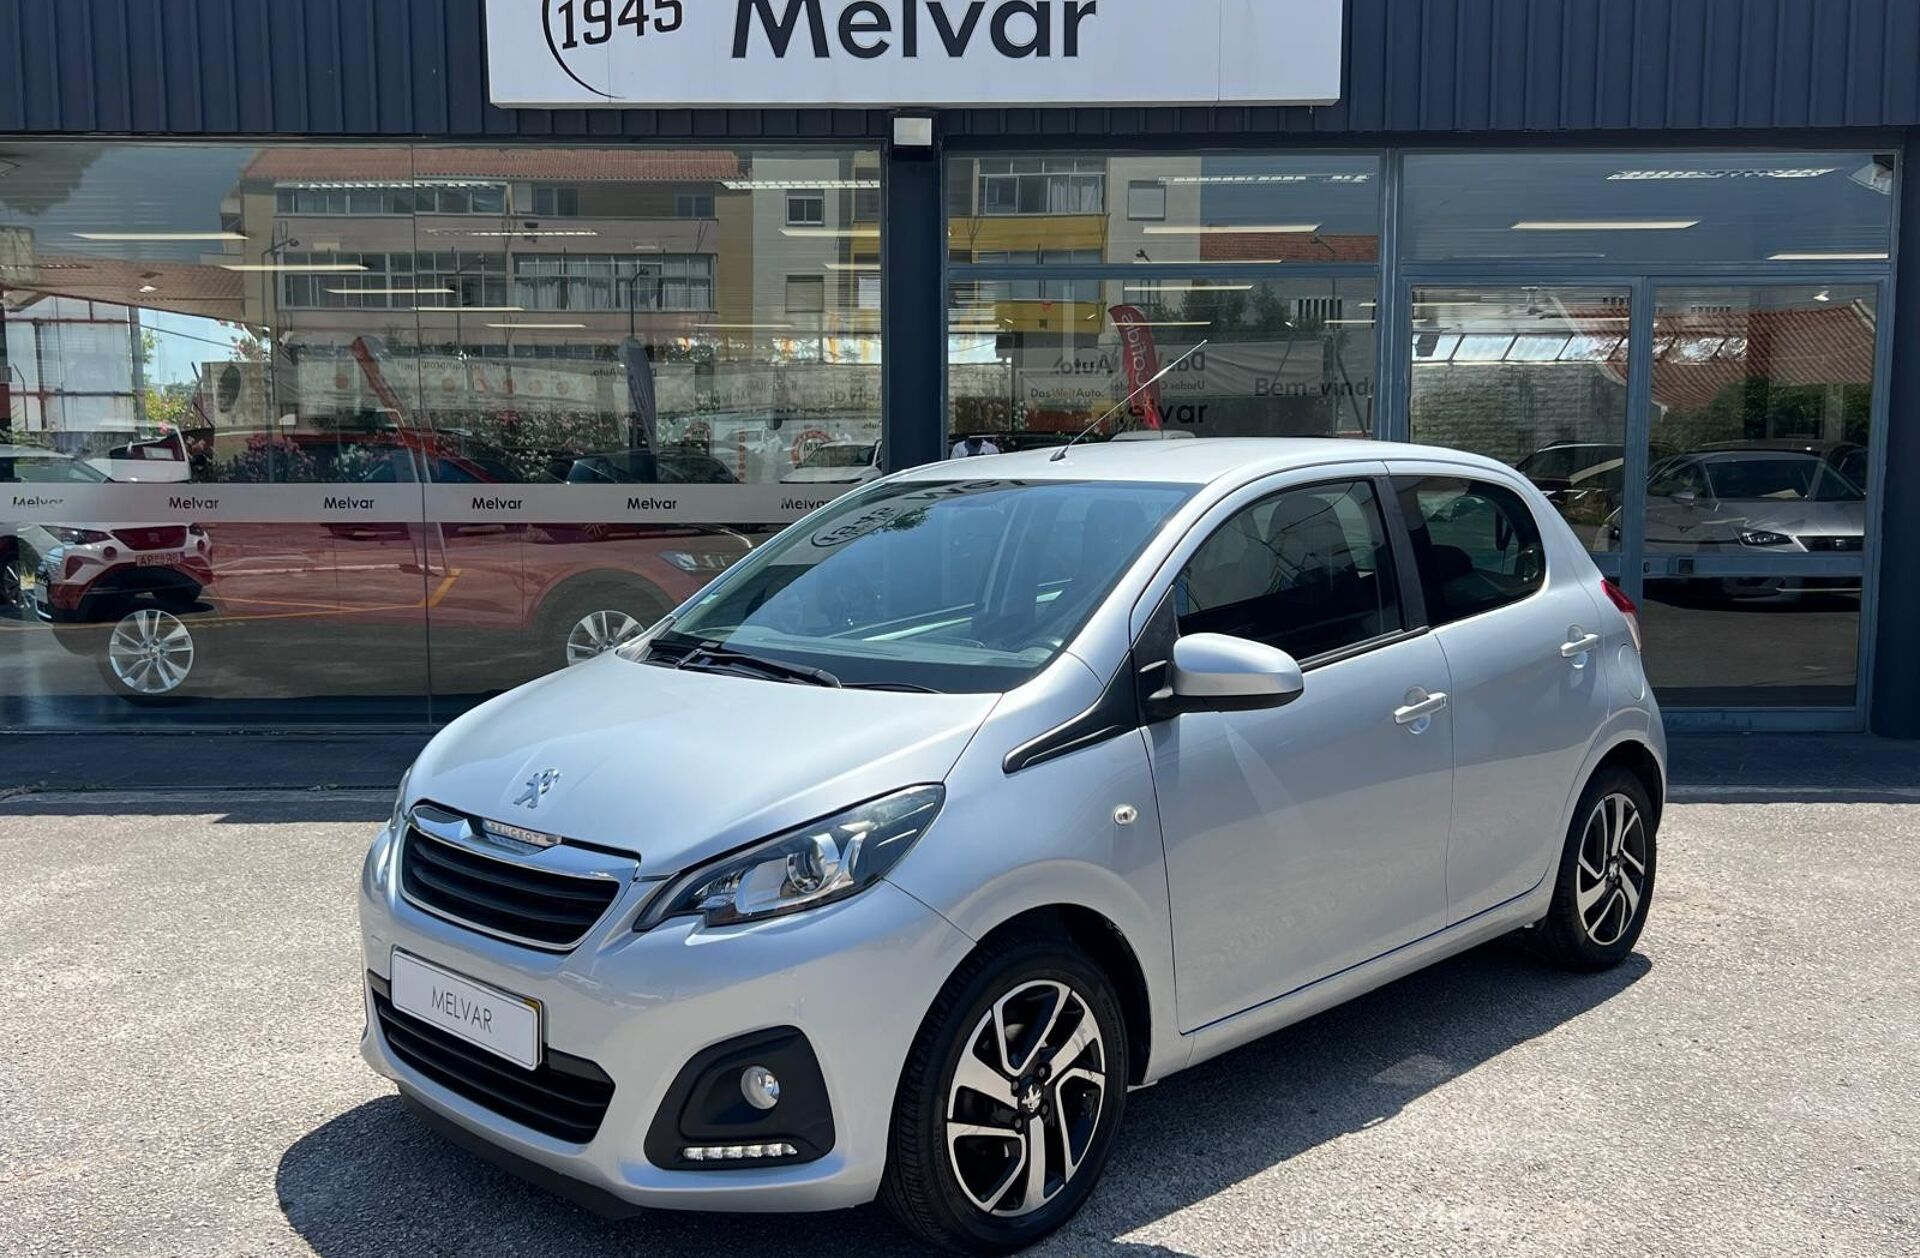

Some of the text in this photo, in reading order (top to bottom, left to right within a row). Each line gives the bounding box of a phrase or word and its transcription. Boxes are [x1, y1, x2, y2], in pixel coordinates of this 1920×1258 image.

[557, 0, 683, 50] 1945
[731, 0, 1097, 59] Melvar
[1254, 377, 1375, 396] Bem-vind
[168, 496, 220, 509] Melvar
[323, 496, 375, 509] Melvar
[472, 497, 523, 510] Melvar
[627, 497, 678, 510] Melvar
[431, 984, 493, 1033] MELVAR
